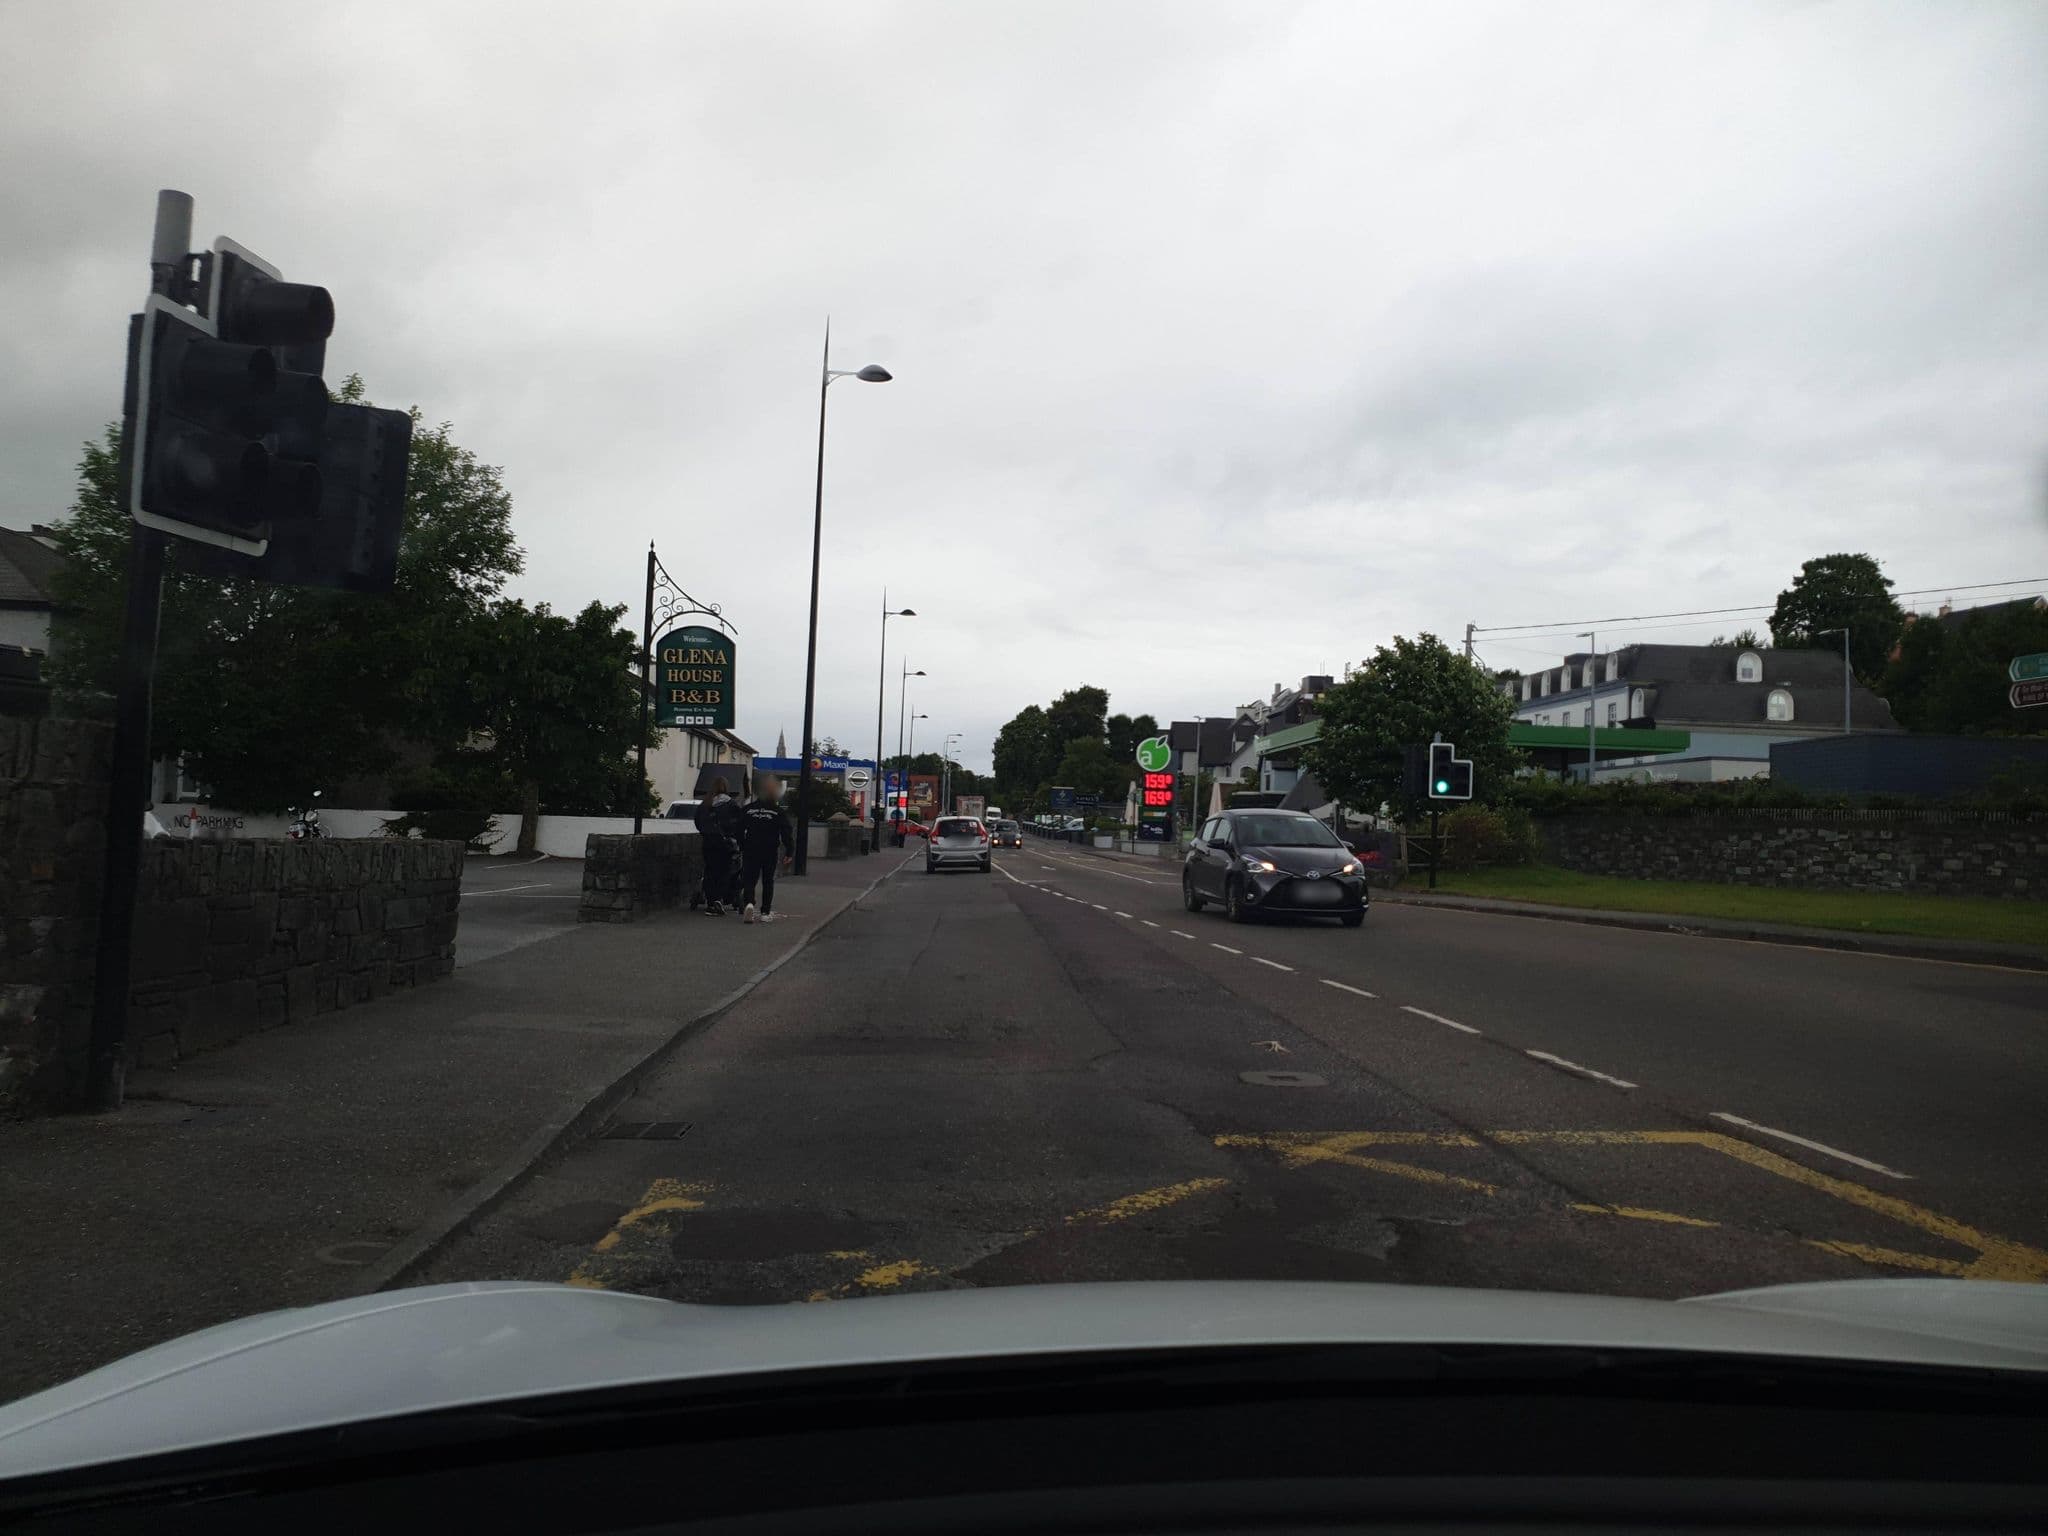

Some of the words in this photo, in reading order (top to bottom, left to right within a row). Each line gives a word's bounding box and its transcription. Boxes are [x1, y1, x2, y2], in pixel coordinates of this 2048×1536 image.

[663, 648, 728, 665] GLENA
[668, 669, 722, 683] HOUSE
[671, 689, 721, 704] B&B
[823, 760, 849, 769] Maxol
